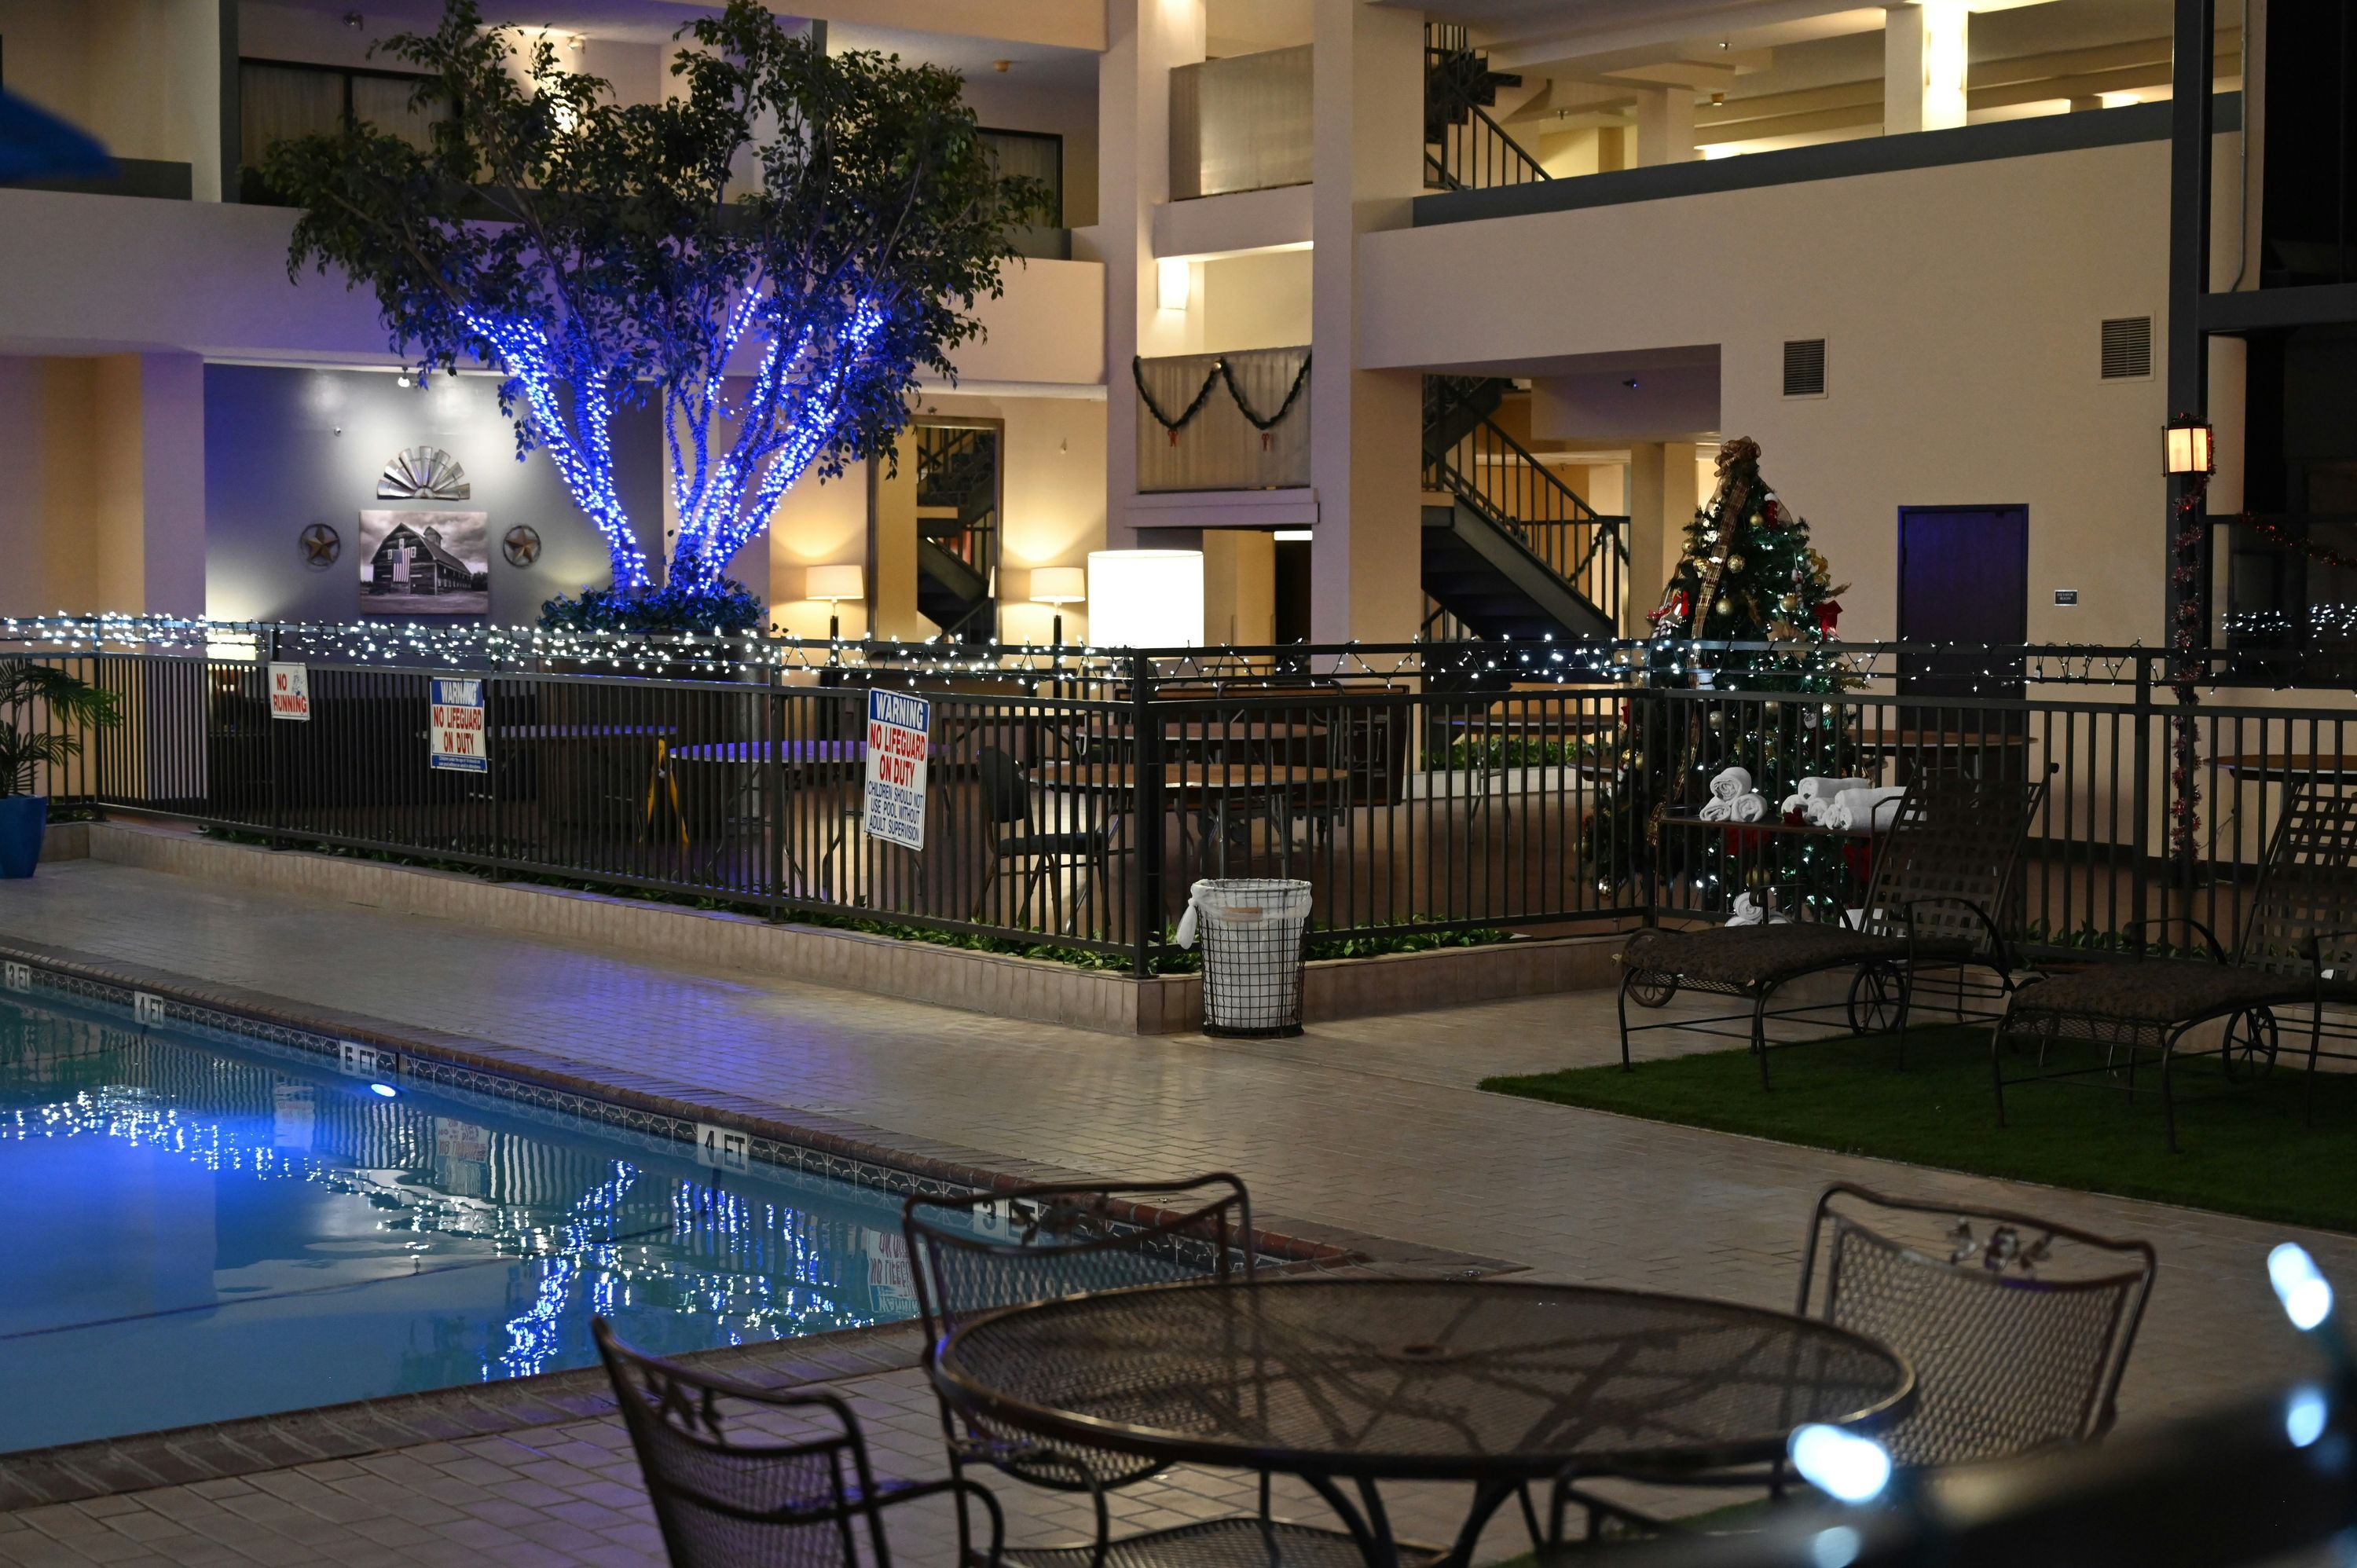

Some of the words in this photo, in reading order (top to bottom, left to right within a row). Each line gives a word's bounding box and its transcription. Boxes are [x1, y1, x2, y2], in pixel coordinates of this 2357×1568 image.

[277, 673, 287, 691] NO
[441, 681, 477, 705] WARNING
[273, 694, 307, 713] RUNNING
[876, 693, 923, 730] WARNING
[434, 706, 444, 727] NO
[447, 707, 482, 731] LIFEGUARD
[444, 731, 453, 753] ON
[456, 732, 474, 754] DUTY
[871, 724, 882, 750] NO
[885, 727, 926, 761] LIFEGUARD
[880, 754, 891, 782] ON
[894, 757, 915, 788] DUTY
[868, 780, 893, 800] CHILDREN
[894, 787, 912, 806] SHOULD
[914, 793, 923, 809] NOT
[871, 797, 881, 814] USE
[884, 801, 896, 819] POOL
[899, 804, 920, 825] WITHOUT
[869, 815, 886, 831] ADULT
[889, 819, 919, 842] SUPERVISION
[724, 1134, 745, 1156] FT
